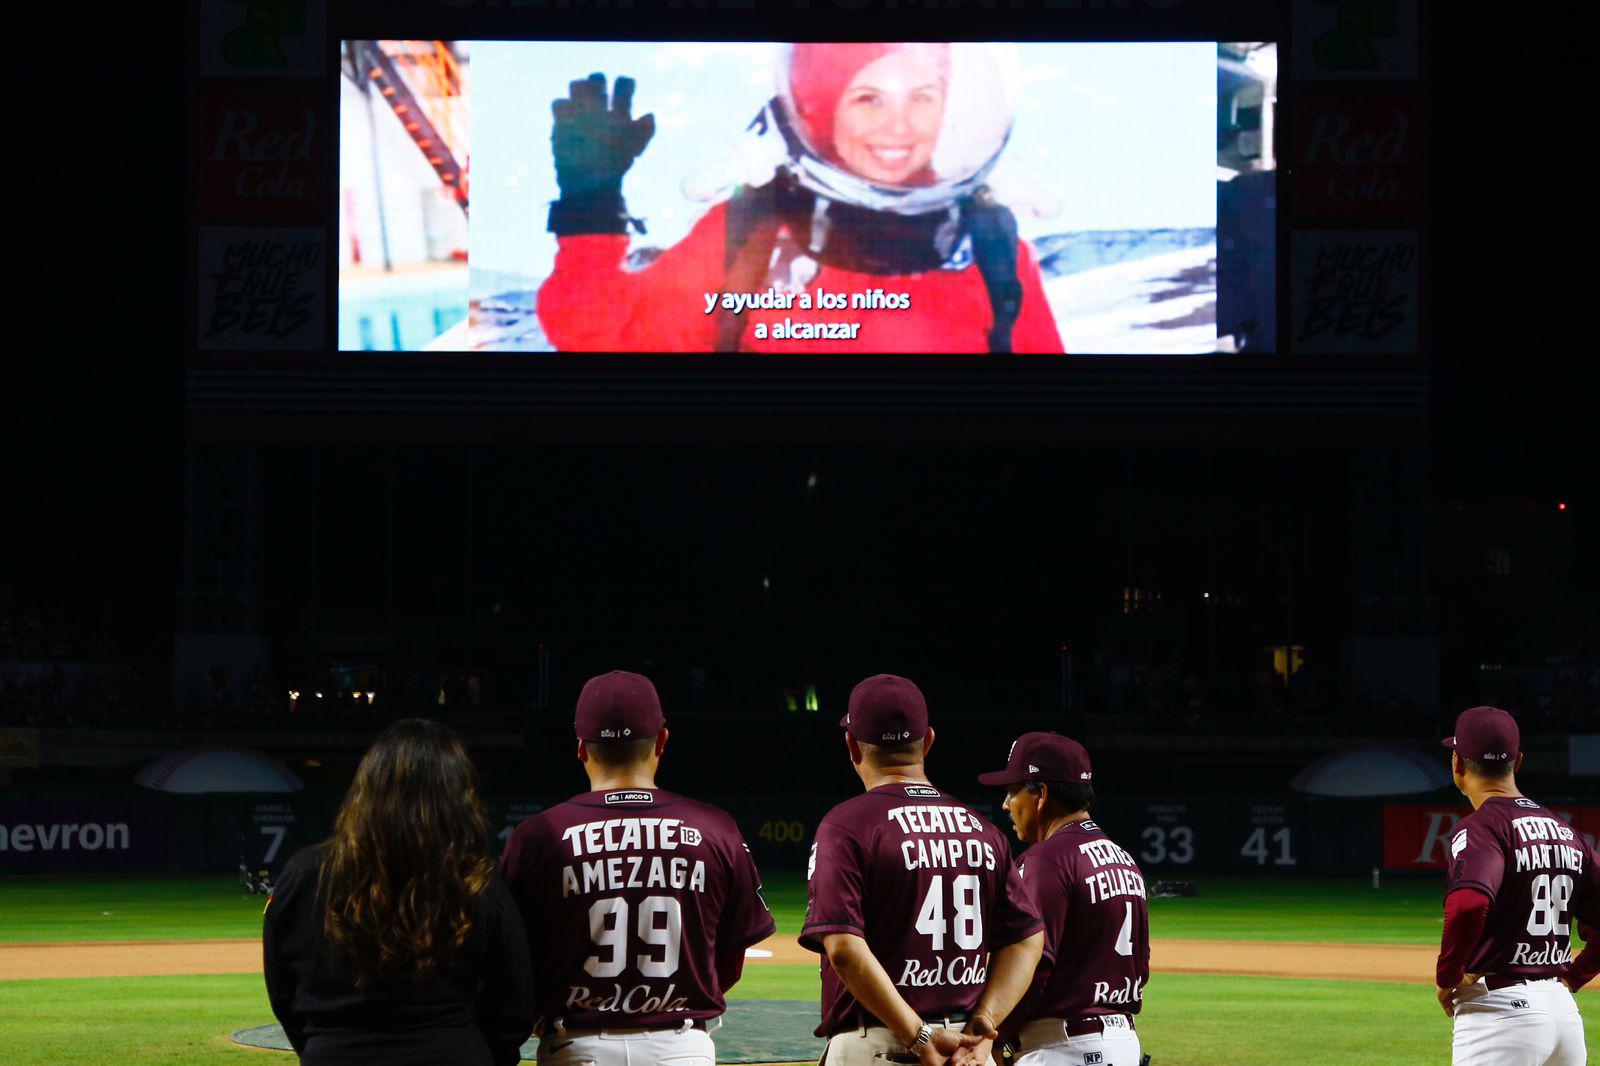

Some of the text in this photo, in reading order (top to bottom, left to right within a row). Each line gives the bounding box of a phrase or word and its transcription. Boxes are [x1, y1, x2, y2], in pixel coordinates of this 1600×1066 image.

[206, 106, 317, 161] Red
[1300, 108, 1408, 164] Red
[234, 166, 307, 200] Cola
[1327, 167, 1403, 201] Cola
[222, 240, 320, 268] MUCHO
[1316, 243, 1414, 272] MUCHO
[243, 269, 302, 297] QUE
[1336, 272, 1394, 300] QUE
[704, 288, 911, 314] y ayudar a los niños
[754, 318, 861, 340] a alcanzar
[756, 820, 806, 843] 400
[888, 806, 972, 834] TECATE
[260, 826, 287, 864] 7
[562, 818, 702, 857] TECATE 18+
[1140, 826, 1195, 864] 33
[1240, 827, 1297, 866] 41
[901, 839, 996, 871] CAMPOS
[563, 857, 705, 898] AMEZAGA
[915, 875, 983, 950] 48
[1526, 874, 1574, 936] 88
[583, 896, 682, 978] 99
[1508, 940, 1550, 966] Red
[896, 955, 986, 986] Red Cola
[565, 983, 688, 1014] Red Cola
[1093, 976, 1131, 1005] Red
[1513, 1000, 1527, 1008] NP
[1085, 1053, 1101, 1064] NP
